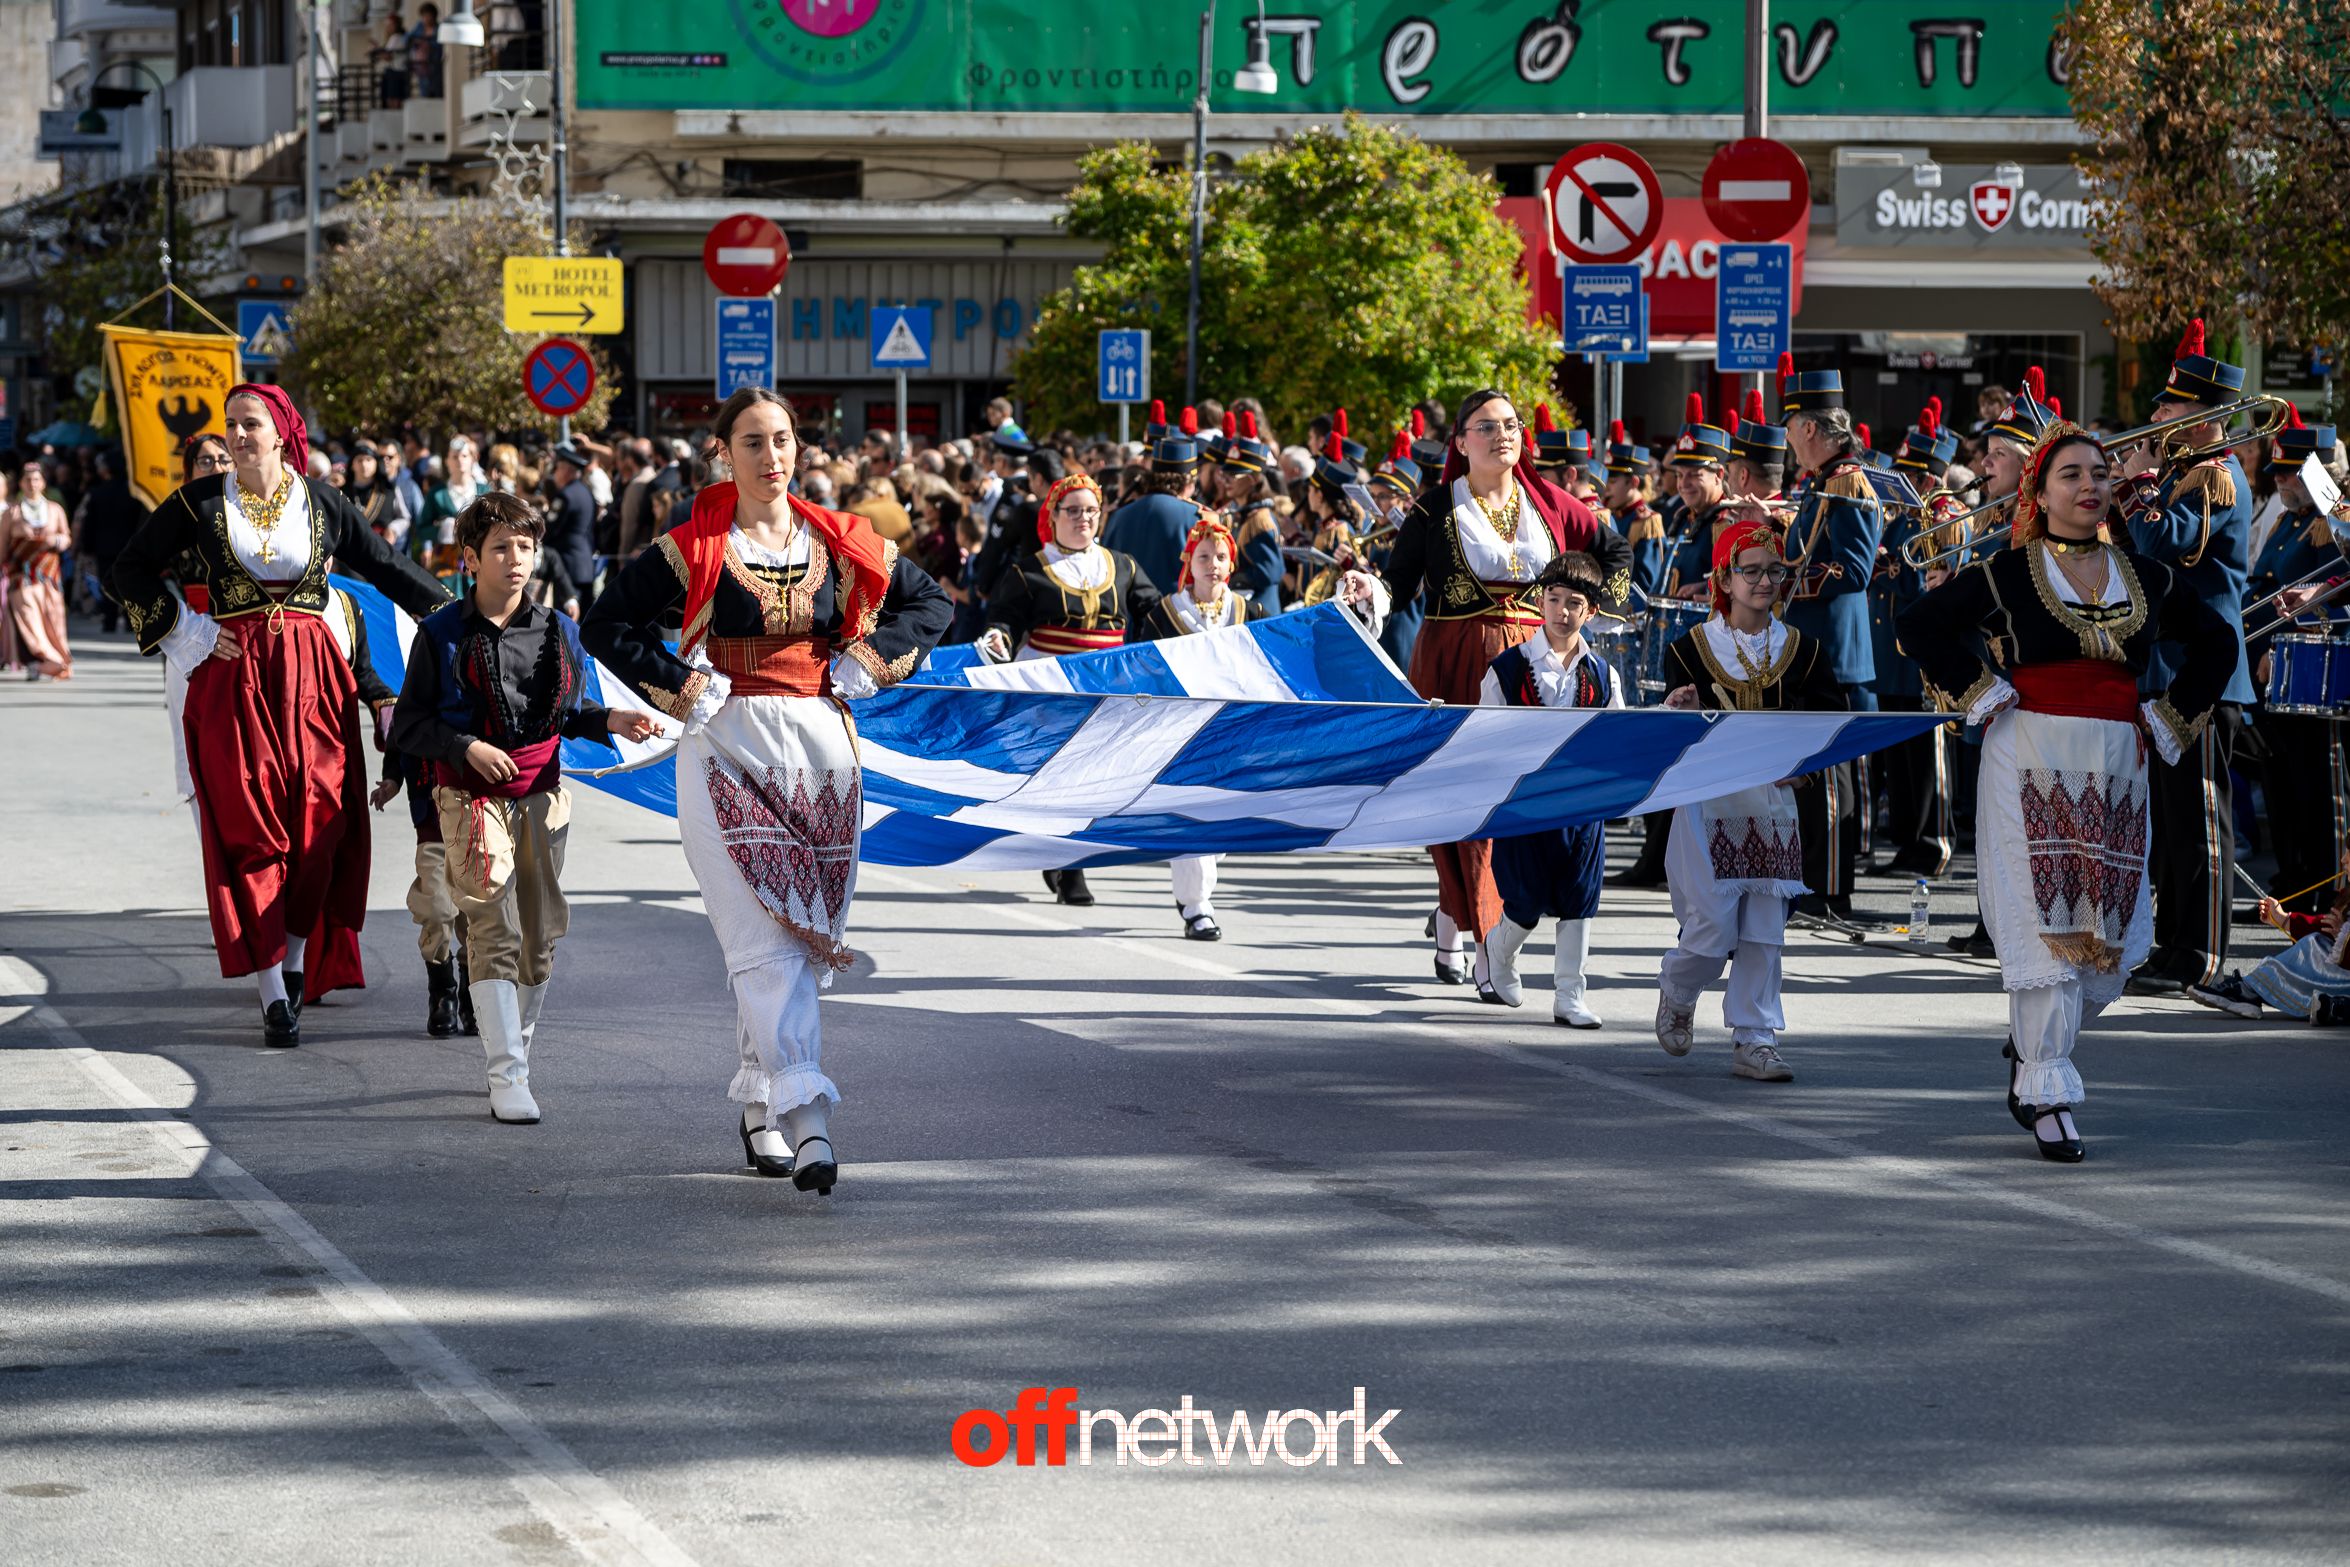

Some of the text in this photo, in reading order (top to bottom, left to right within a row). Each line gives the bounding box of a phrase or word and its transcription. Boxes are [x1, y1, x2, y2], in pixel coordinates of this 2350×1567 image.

[970, 61, 1233, 96] Φροντιστήρο
[1875, 188, 2118, 228] Swiss Corn
[553, 267, 614, 282] HOTEL
[515, 283, 614, 297] METROPOL
[1576, 304, 1630, 325] ΤΑΞΙ
[1730, 332, 1776, 350] ΤΑΞΙ
